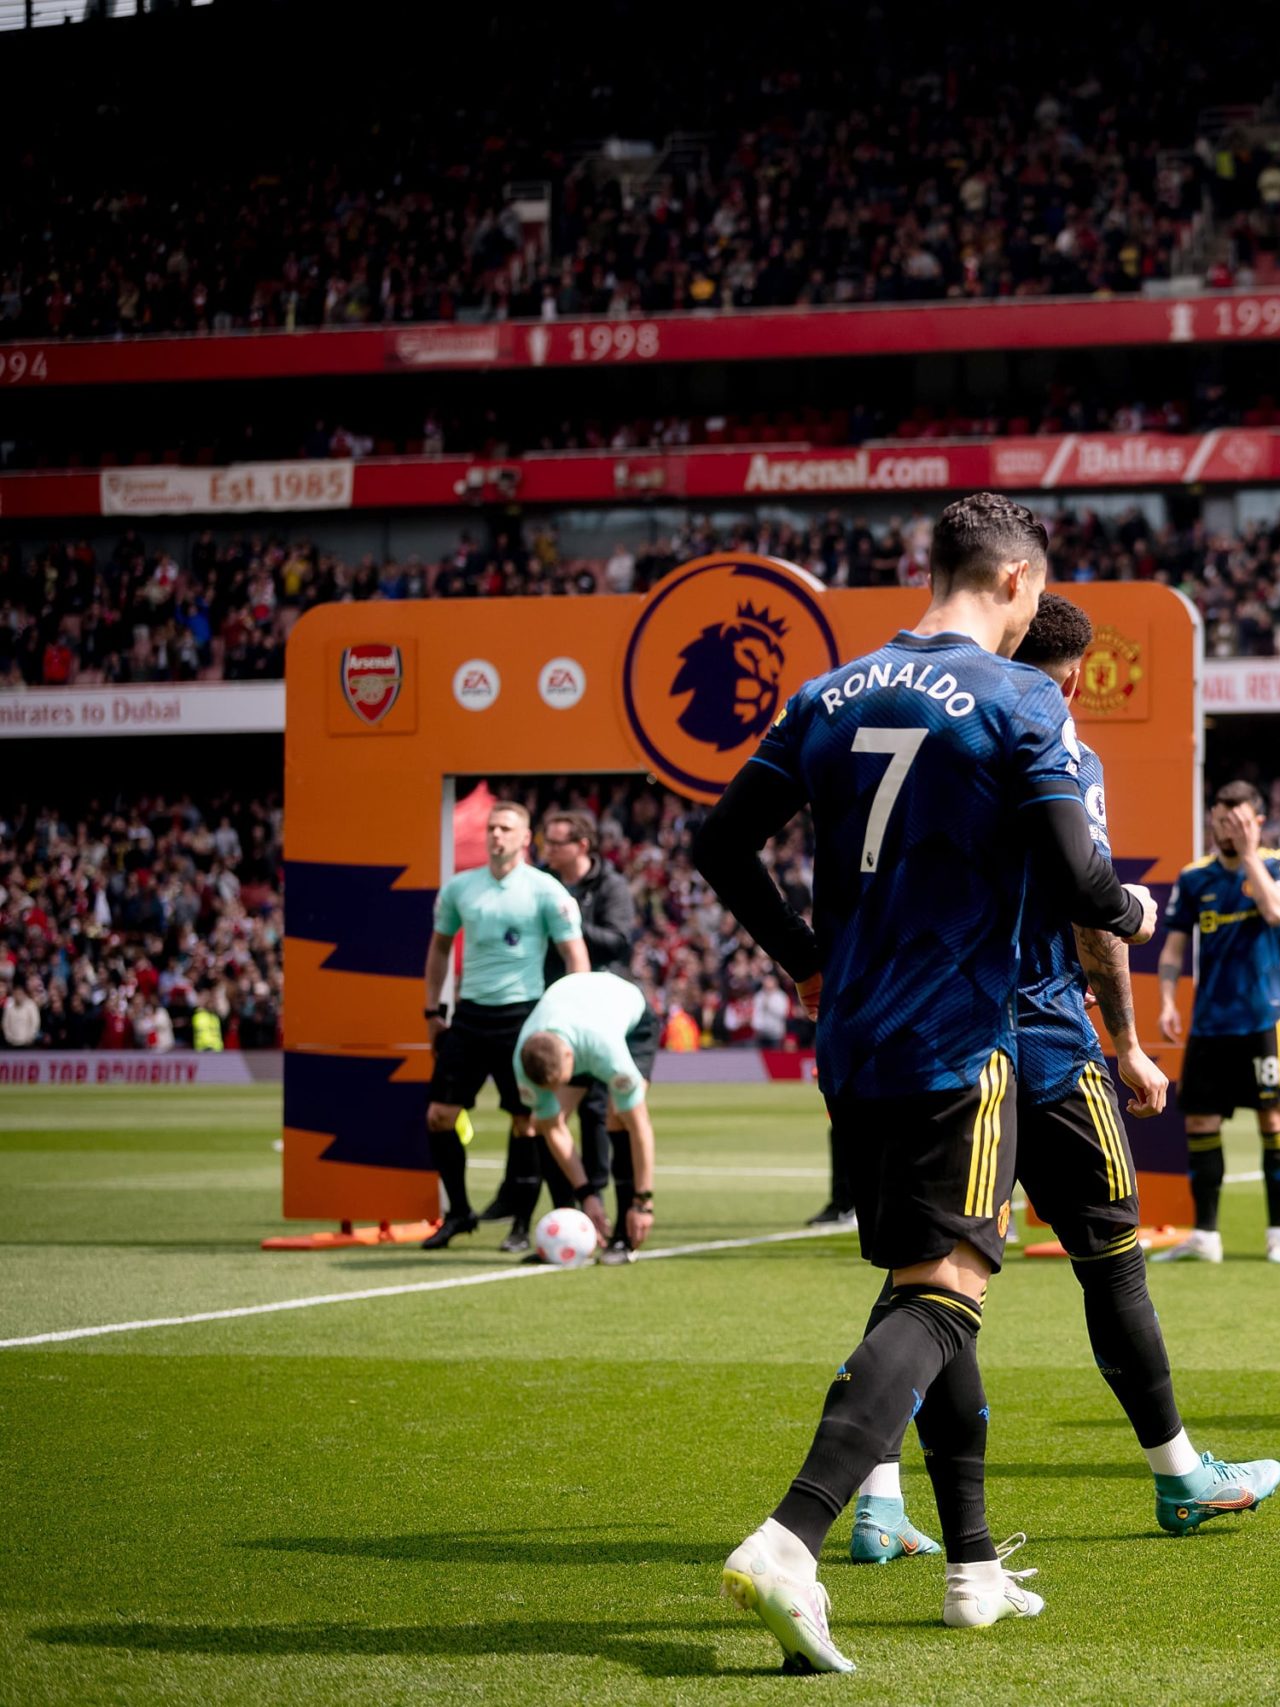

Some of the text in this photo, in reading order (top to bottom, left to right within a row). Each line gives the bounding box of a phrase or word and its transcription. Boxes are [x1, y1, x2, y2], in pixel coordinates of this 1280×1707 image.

[568, 323, 660, 361] 1998
[272, 467, 346, 501] 1985
[744, 451, 950, 492] Arsenal.com
[349, 654, 396, 671] Arsenal
[548, 668, 577, 688] EA
[462, 670, 491, 689] EA
[821, 662, 976, 718] RONALDO
[81, 702, 105, 726] to
[112, 696, 182, 725] Dubai
[850, 727, 929, 873] 7
[49, 1060, 88, 1084] TOP
[1252, 1055, 1280, 1087] 18
